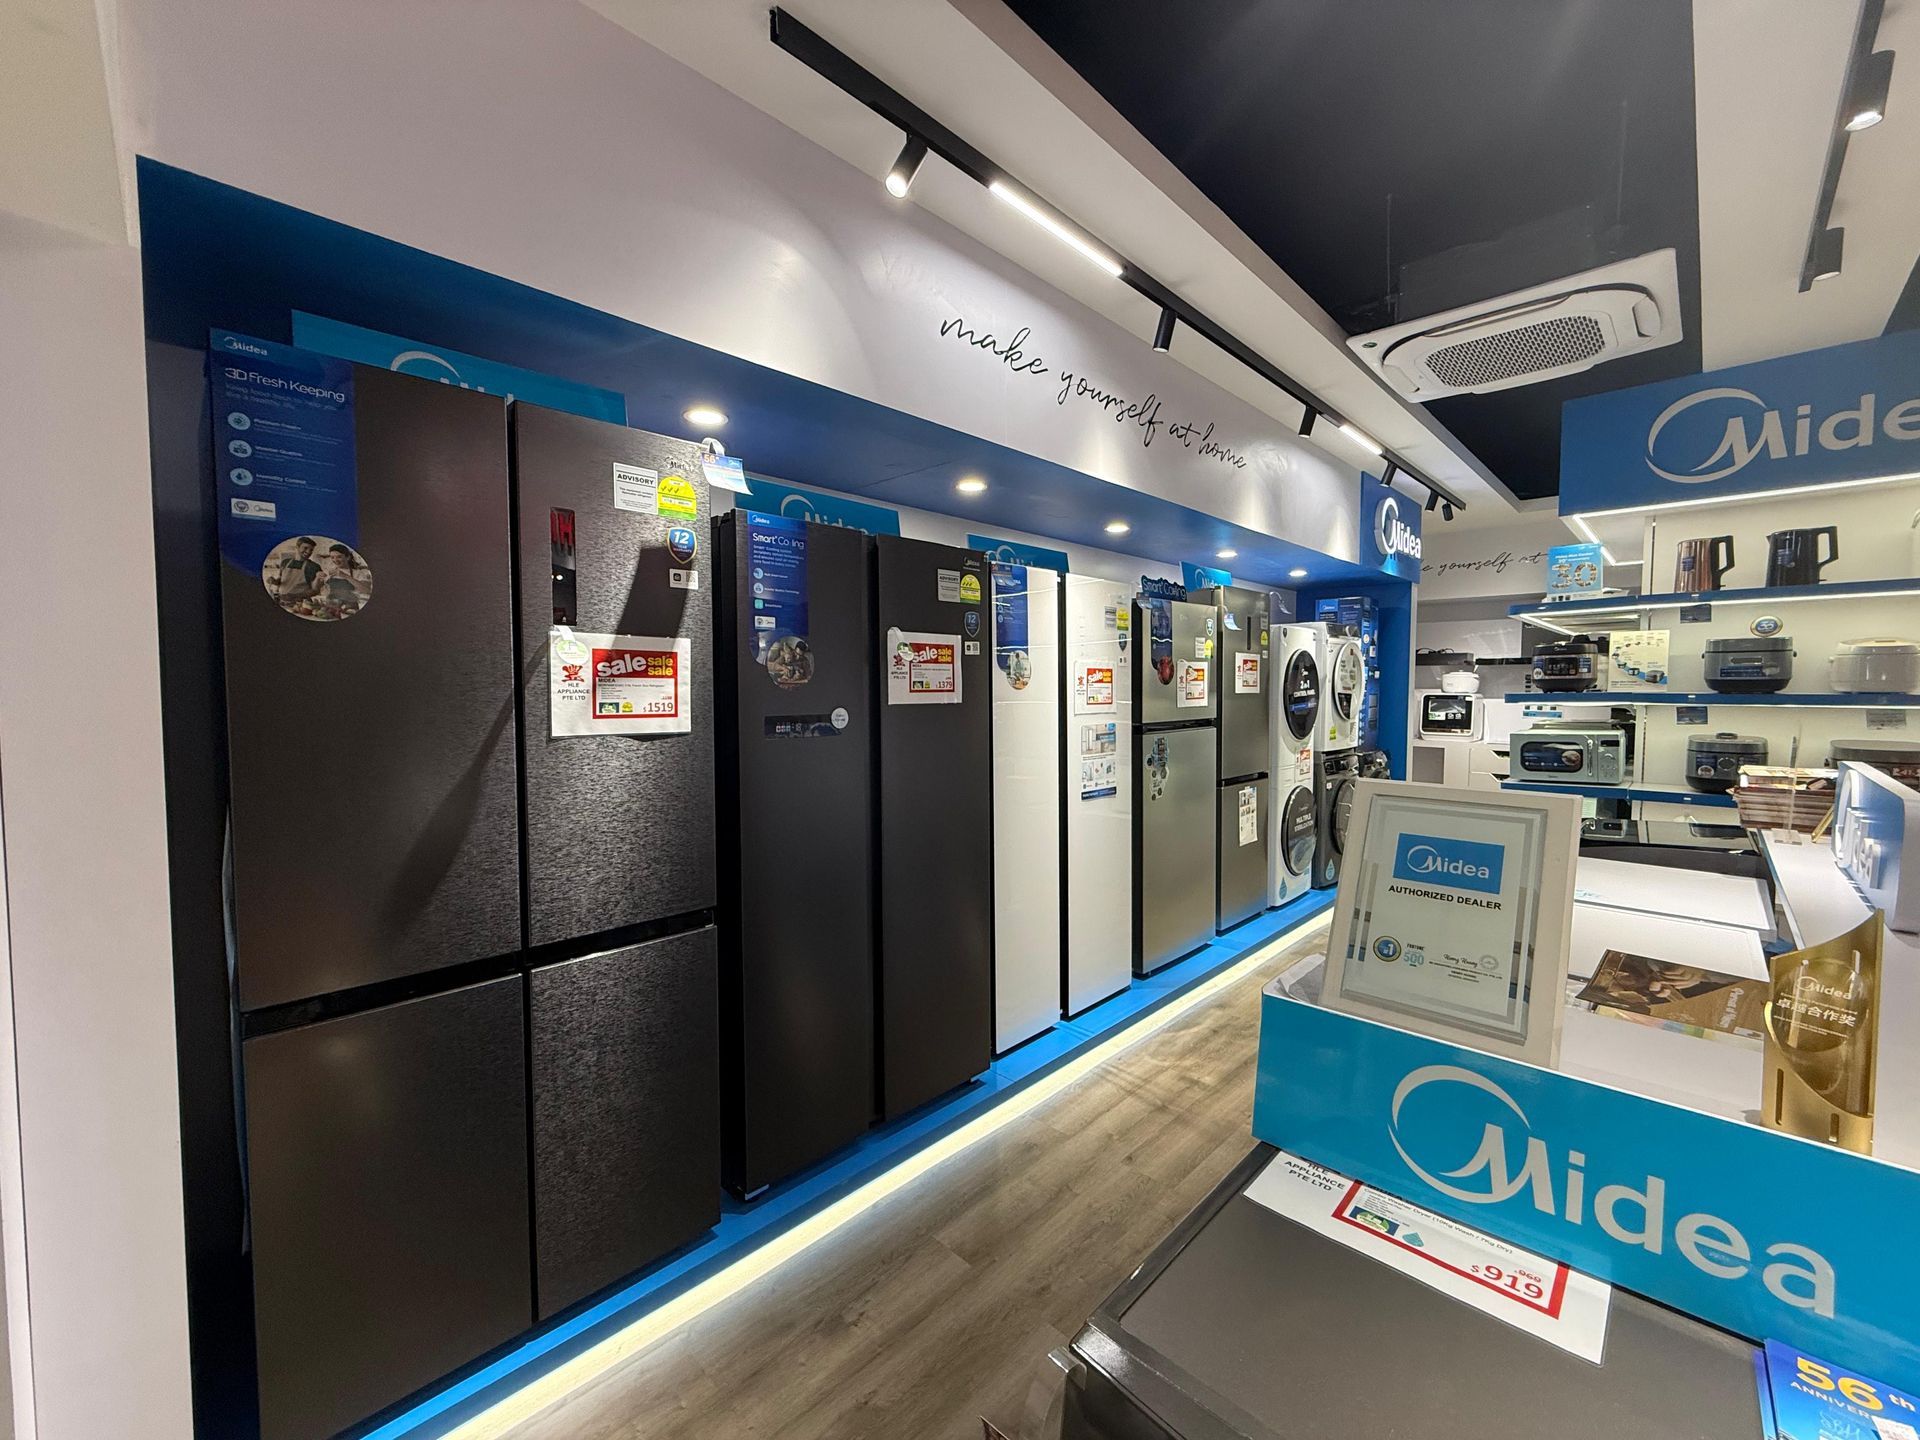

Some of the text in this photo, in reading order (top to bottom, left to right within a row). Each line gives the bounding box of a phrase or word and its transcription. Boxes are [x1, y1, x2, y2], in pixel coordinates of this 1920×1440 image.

[224, 336, 268, 356] Midea
[225, 367, 345, 403] 3D Fresh Keeping
[940, 318, 1247, 468] make yourself at home
[1645, 388, 1920, 484] Mide
[617, 473, 654, 485] ADVISORY
[674, 531, 689, 544] 12
[1378, 497, 1421, 559] Midea
[1440, 552, 1514, 576] yourself
[1552, 562, 1597, 589] 30
[968, 615, 976, 623] 12
[597, 654, 673, 677] sale sale
[912, 646, 938, 662] sale
[648, 665, 673, 676] sale
[1407, 845, 1489, 879] Midea
[1388, 885, 1502, 910] AUTHORIZED DEALER
[1402, 952, 1424, 966] 500
[1407, 943, 1425, 951] FORTUNE
[1798, 976, 1852, 1000] Midea
[1776, 998, 1857, 1027] 卓越合作奖
[1285, 1161, 1346, 1190] APPLIANCE
[1288, 1170, 1332, 1191] PTE LTD
[1387, 1064, 1836, 1319] Midea
[1388, 1197, 1413, 1210] Washer
[1413, 1208, 1434, 1219] Dryer
[1455, 1227, 1474, 1237] Wash
[1796, 1357, 1916, 1412] 56 th
